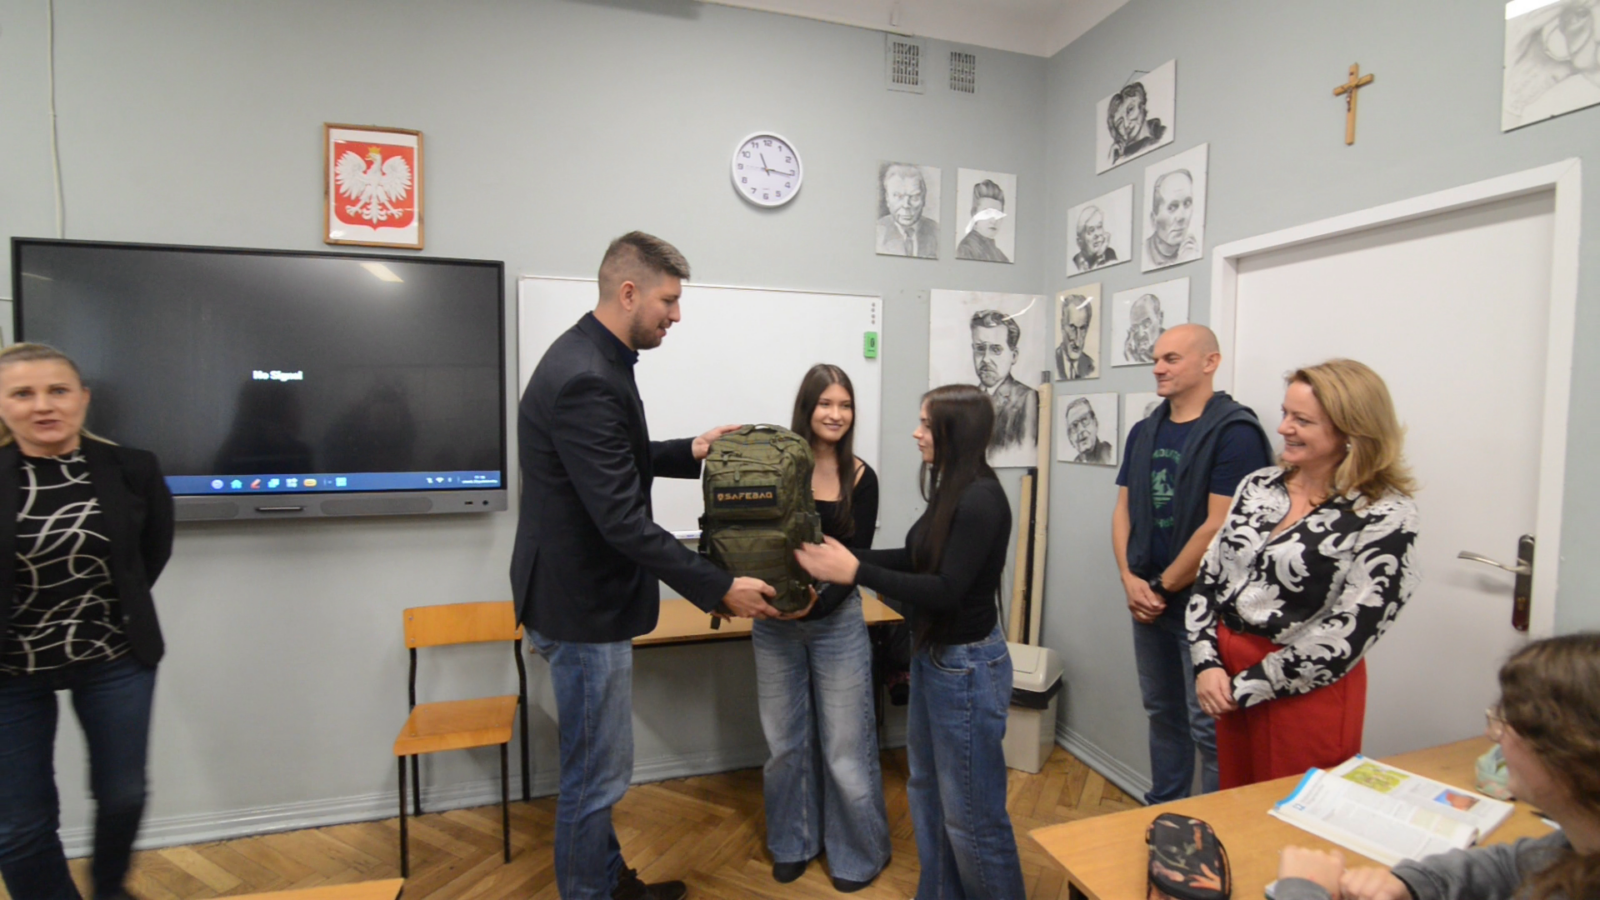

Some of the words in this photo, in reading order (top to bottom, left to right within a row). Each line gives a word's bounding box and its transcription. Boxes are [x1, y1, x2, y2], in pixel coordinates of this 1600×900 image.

[253, 370, 269, 380] No
[270, 370, 303, 382] Signal
[724, 491, 773, 500] SAFEBAG
